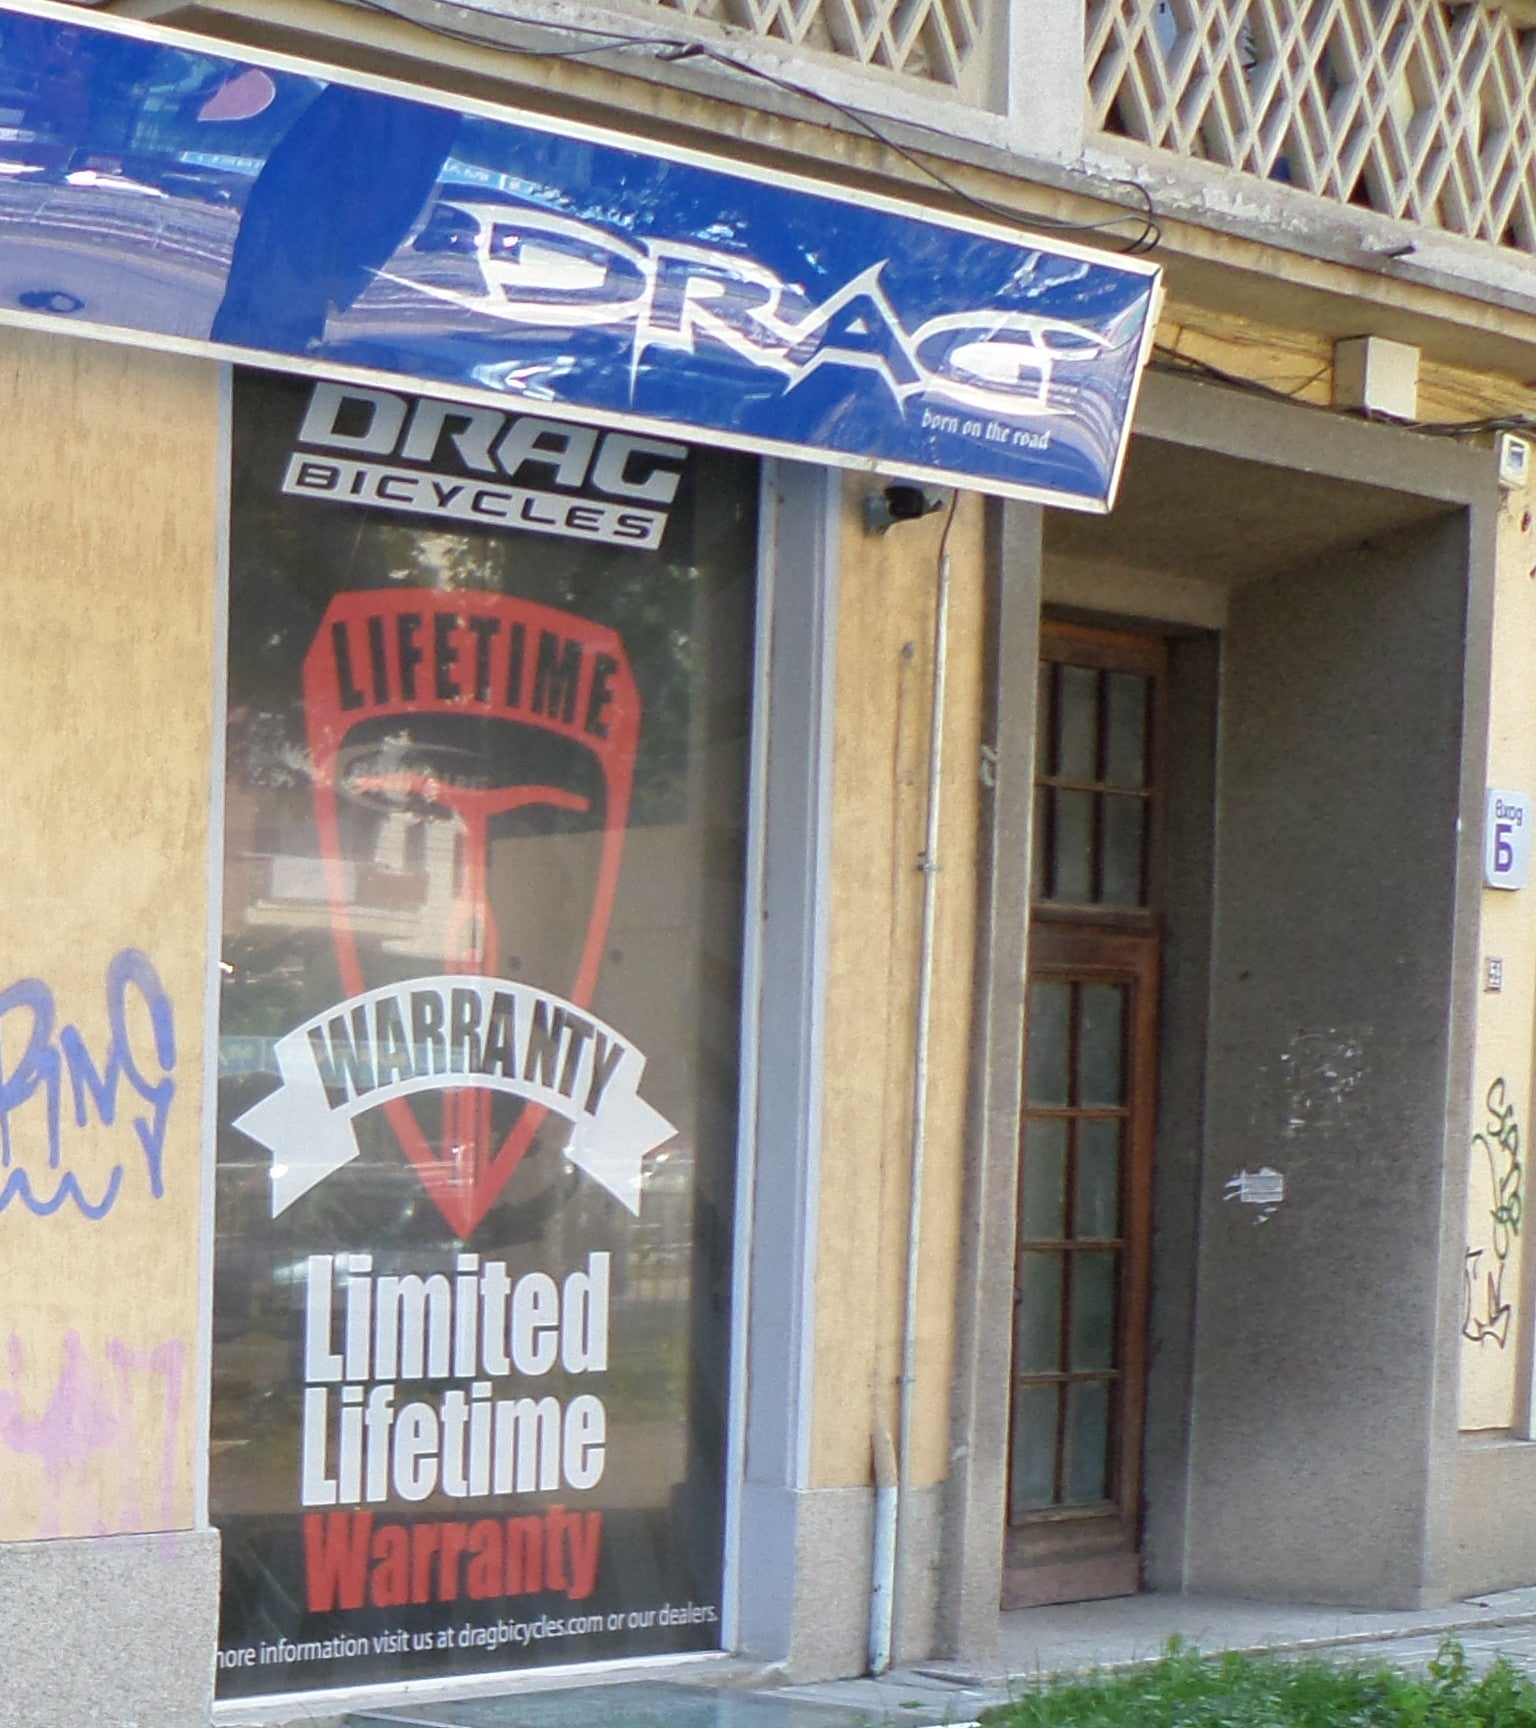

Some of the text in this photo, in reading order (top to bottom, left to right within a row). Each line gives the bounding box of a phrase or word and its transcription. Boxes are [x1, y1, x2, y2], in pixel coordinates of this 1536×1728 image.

[299, 381, 689, 503] DRAG
[962, 419, 981, 438] on
[985, 420, 1010, 442] the
[1013, 430, 1052, 450] road
[295, 462, 655, 540] BICYCLES
[331, 612, 619, 740] LIFETIME
[307, 987, 626, 1117] WARRANTY
[305, 1252, 611, 1382] Limited
[301, 1382, 607, 1506] Lifetime
[303, 1505, 603, 1613] Warranty
[260, 1634, 369, 1665] information
[373, 1629, 410, 1654] visit
[412, 1631, 434, 1651] us
[437, 1630, 456, 1649] at
[459, 1612, 603, 1649] dragbicycles.com
[606, 1613, 625, 1632] or
[627, 1608, 656, 1629] our
[659, 1602, 719, 1626] dealers.
